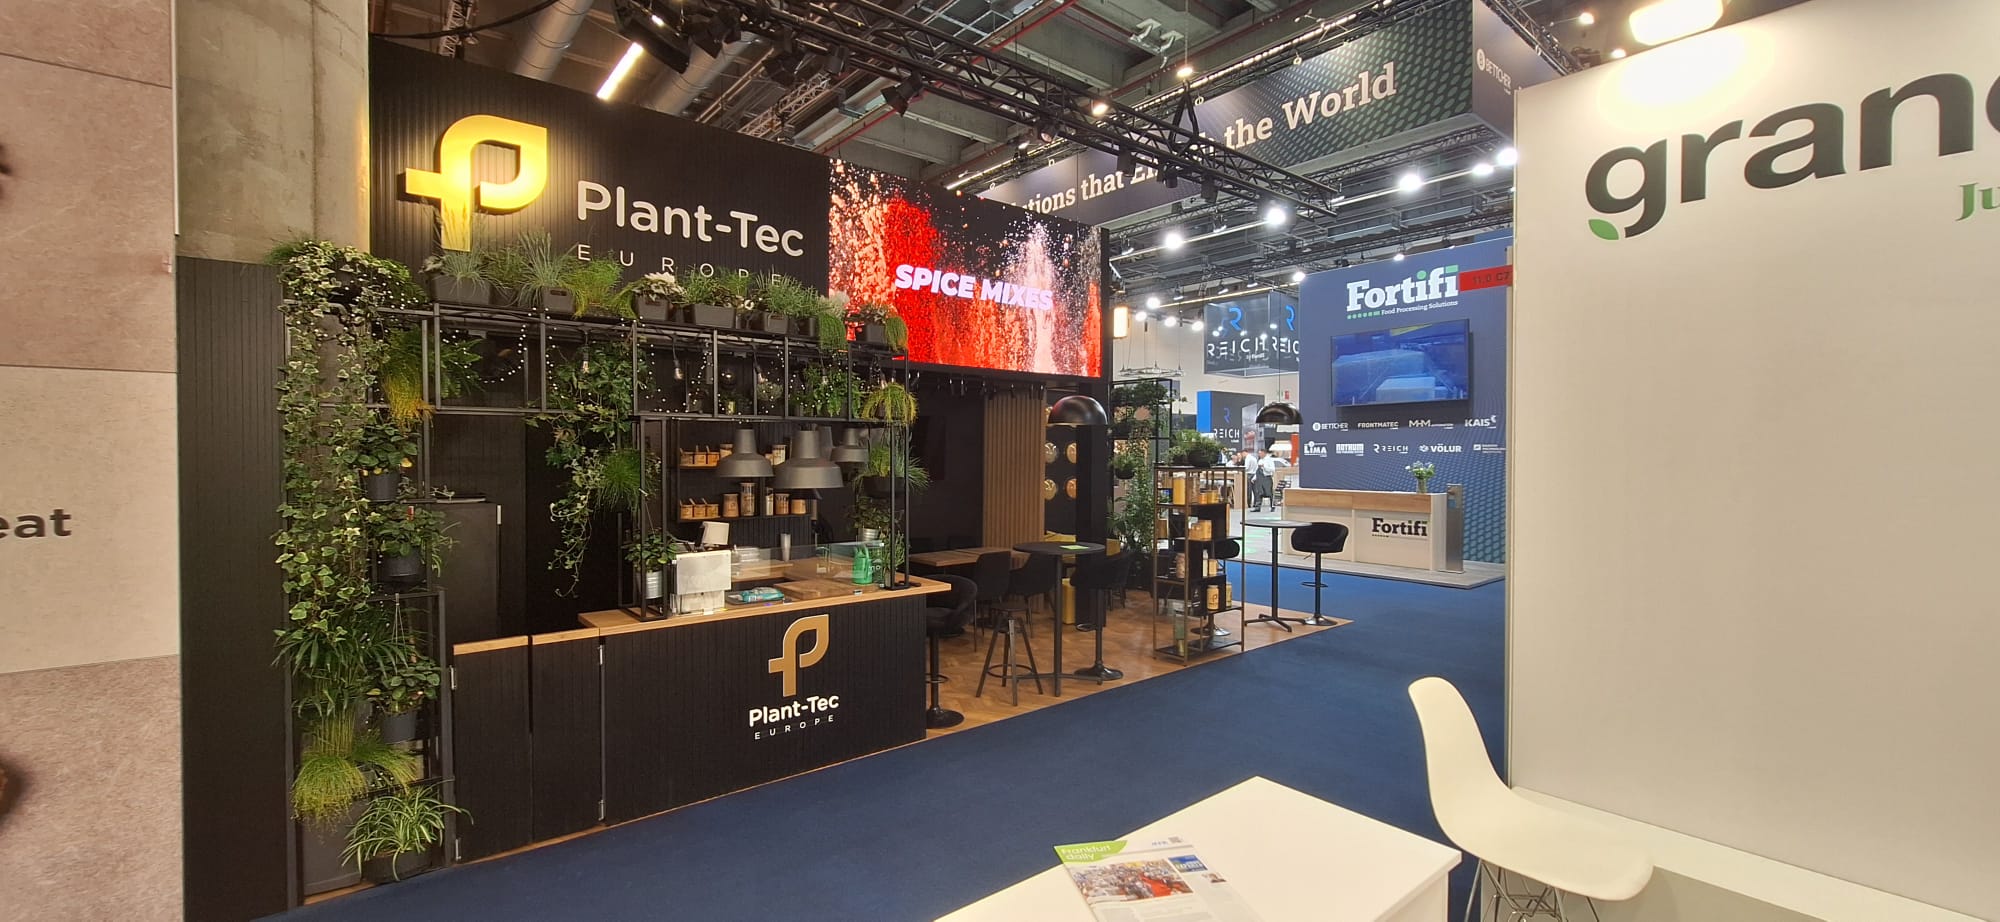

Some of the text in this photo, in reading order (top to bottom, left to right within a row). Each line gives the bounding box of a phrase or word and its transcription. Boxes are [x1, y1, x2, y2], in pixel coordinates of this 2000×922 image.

[1080, 174, 1125, 200] that
[1224, 118, 1273, 150] the
[1282, 61, 1398, 130] World
[577, 180, 804, 257] Plant-Tec
[895, 264, 1063, 311] SPICE MIXES
[1346, 264, 1459, 312] Fortifi
[1381, 301, 1458, 316] Food Processing Solutions
[1207, 337, 1266, 356] REICH
[1213, 428, 1240, 439] REICH
[1430, 443, 1462, 453] VÖLUR
[1371, 517, 1428, 537] Fortifi
[749, 695, 840, 728] Plant-Tec
[754, 714, 834, 740] EUROPE
